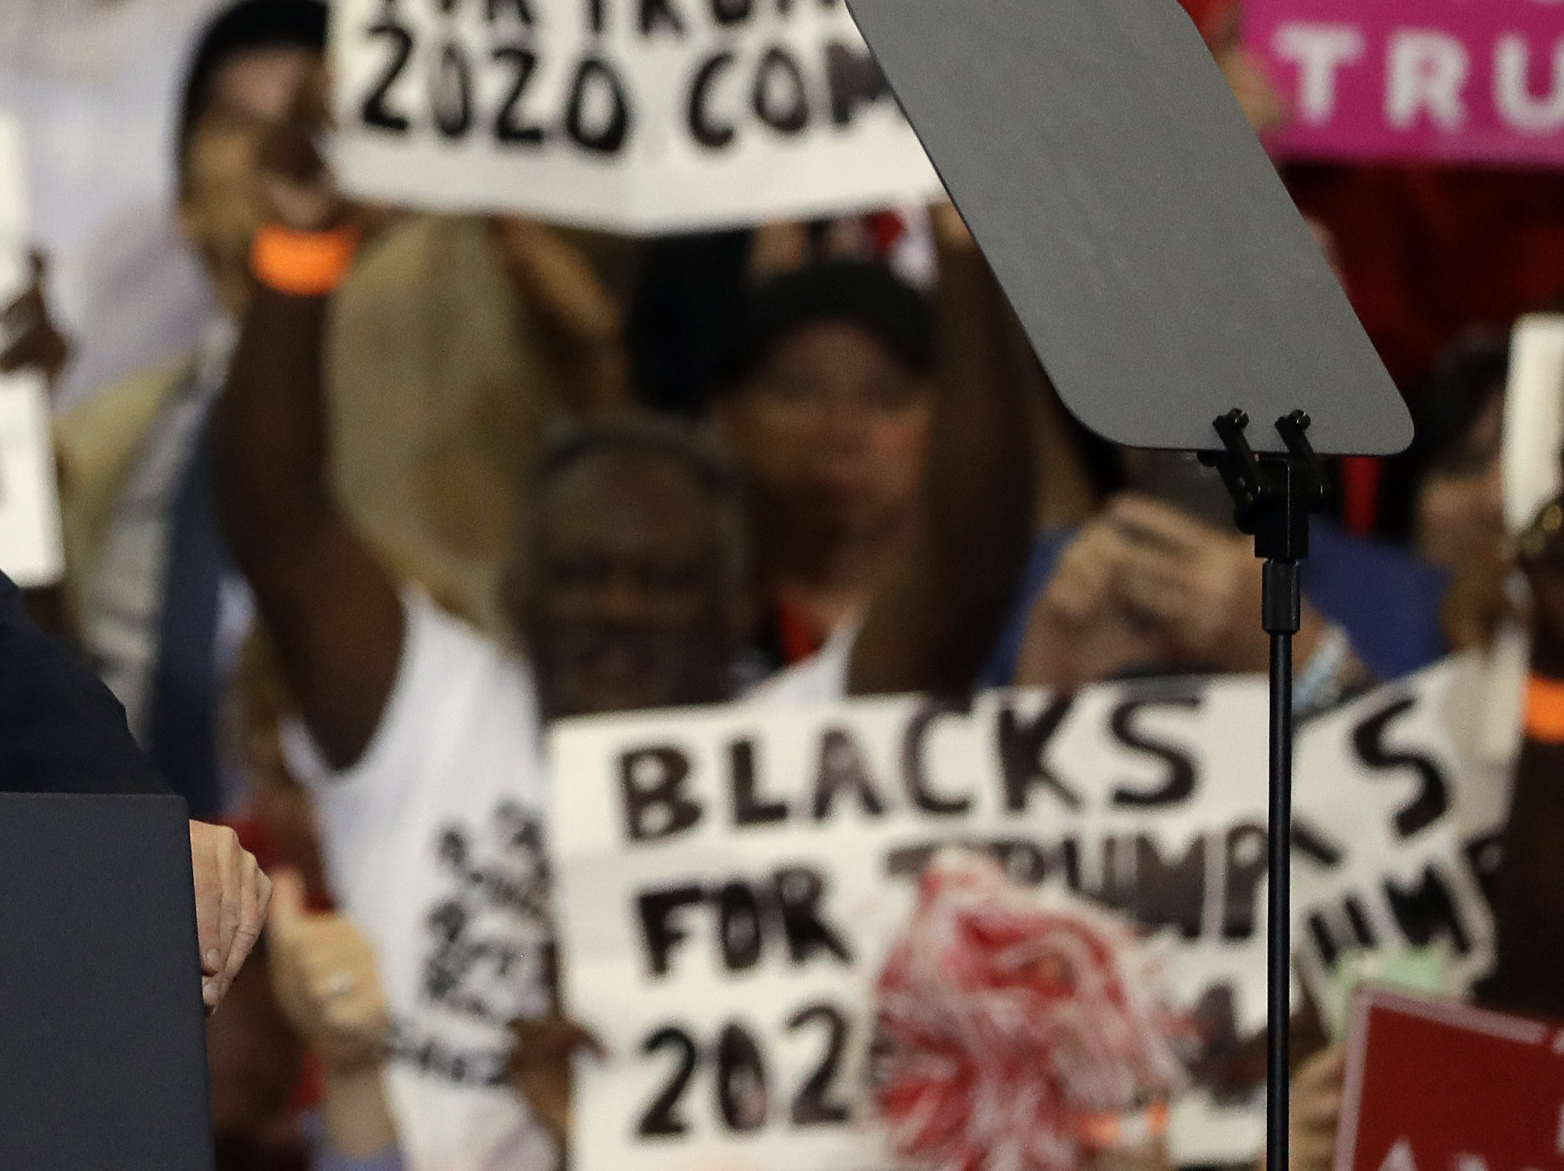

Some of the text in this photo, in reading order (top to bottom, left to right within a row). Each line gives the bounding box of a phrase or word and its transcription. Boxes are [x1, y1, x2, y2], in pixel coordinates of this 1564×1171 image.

[358, 24, 632, 156] 2020
[612, 690, 1204, 844] BLACKS
[636, 860, 856, 978] FOR
[634, 1002, 856, 1140] 202
